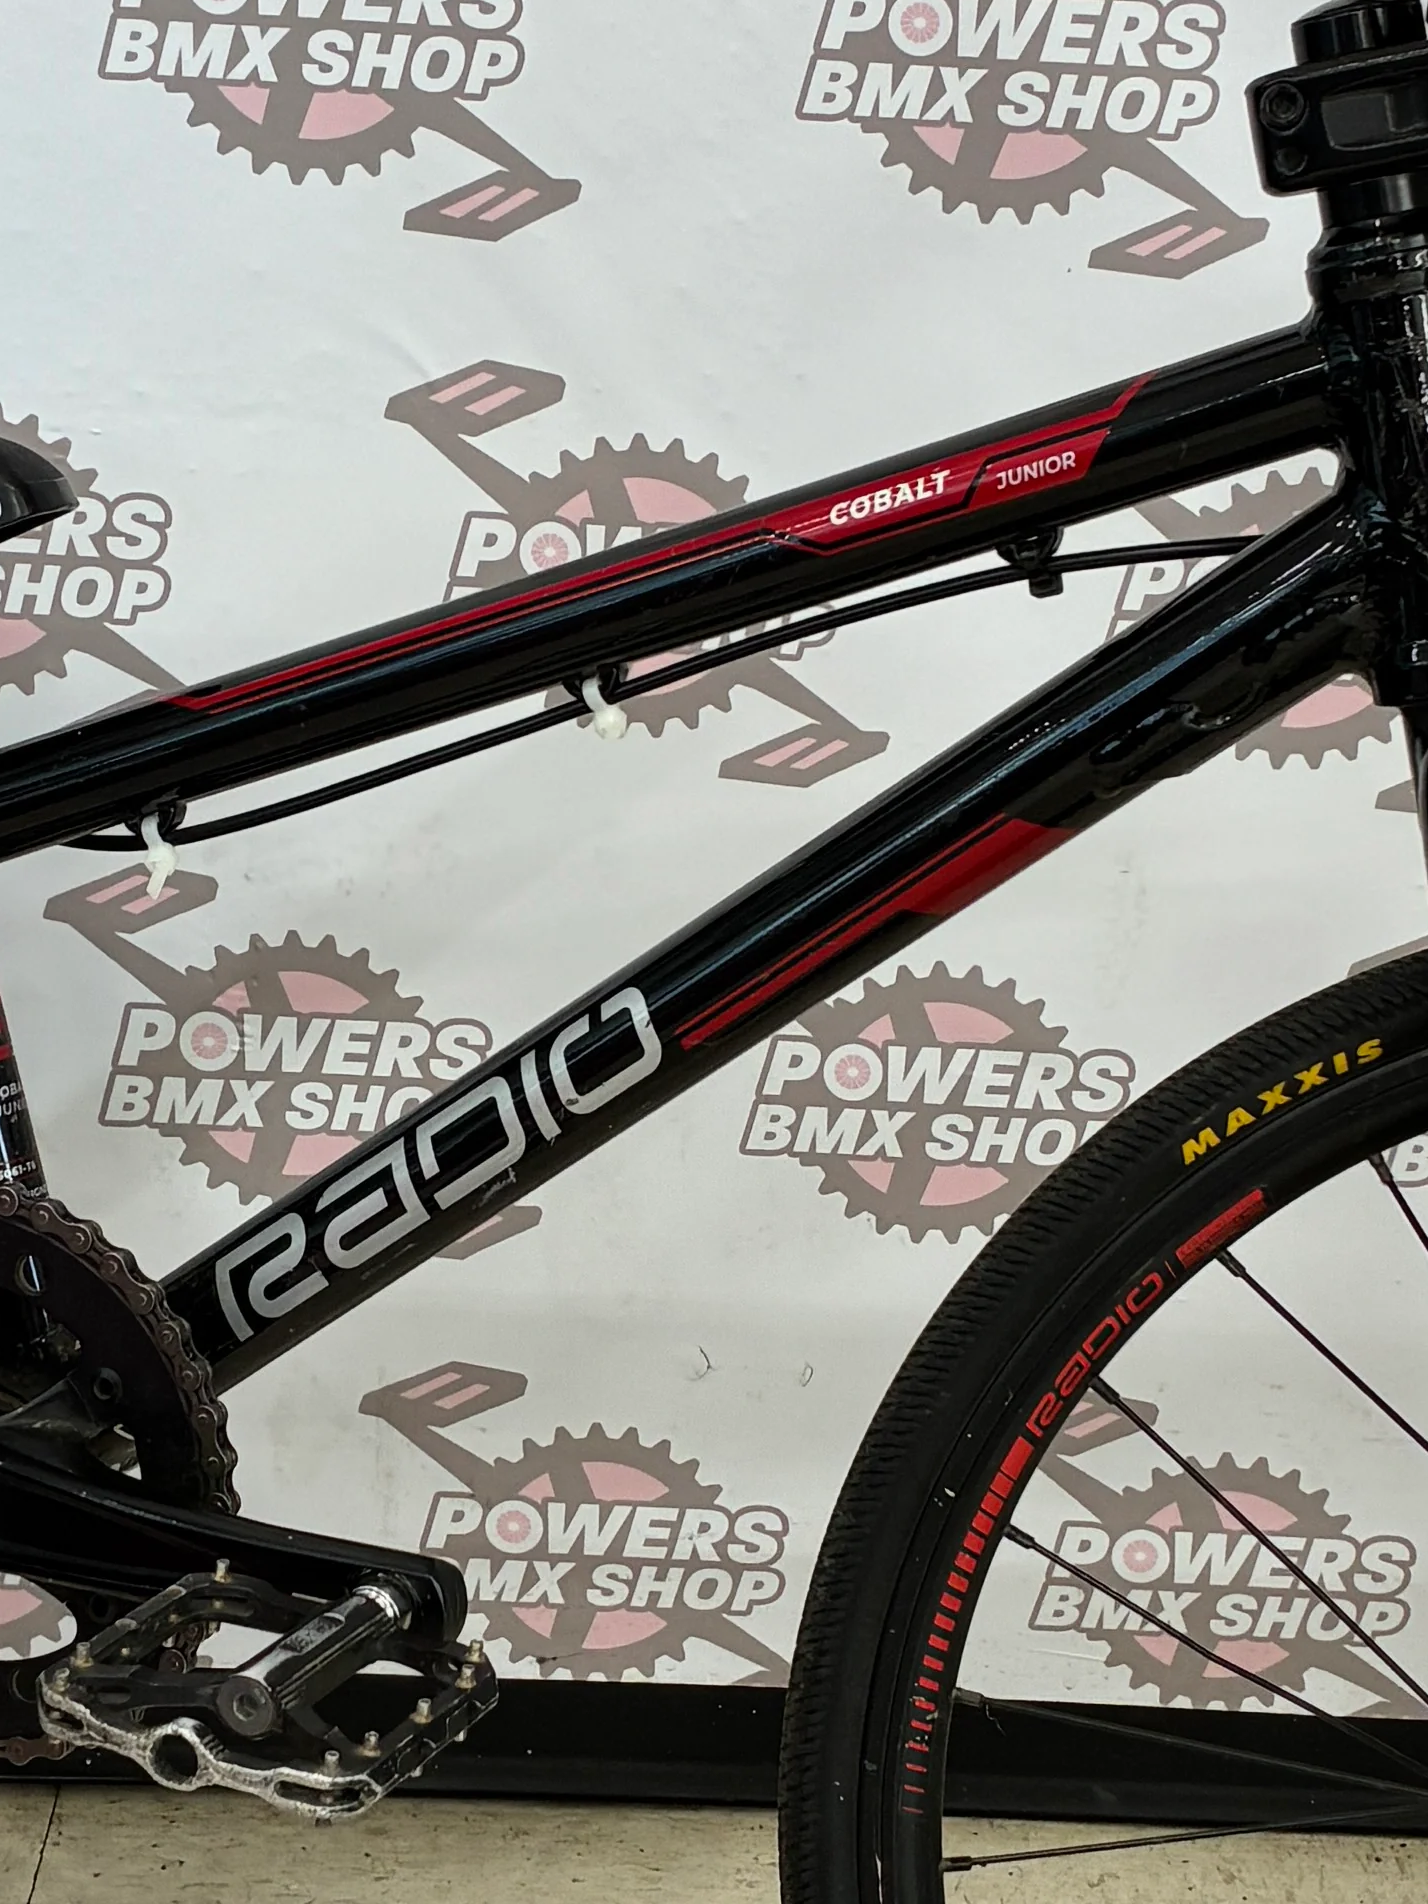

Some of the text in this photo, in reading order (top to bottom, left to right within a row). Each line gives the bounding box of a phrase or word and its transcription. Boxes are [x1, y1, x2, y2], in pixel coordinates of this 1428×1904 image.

[107, 19, 519, 93] BMX SHOP
[803, 61, 1216, 134] BMX SHOP
[829, 451, 1076, 526] COBALT JUNIOR
[118, 1008, 488, 1080] POWERS
[764, 1041, 1130, 1114] POWERS
[106, 1077, 434, 1133] BMX SHO
[748, 1105, 1105, 1165] BMX SHO
[1181, 1038, 1383, 1166] MAXXIS
[428, 1497, 783, 1563] POWERS
[1056, 1527, 1413, 1595] POWERS
[465, 1558, 783, 1614] MX SHOP
[1038, 1585, 1406, 1642] BMX SHOP
